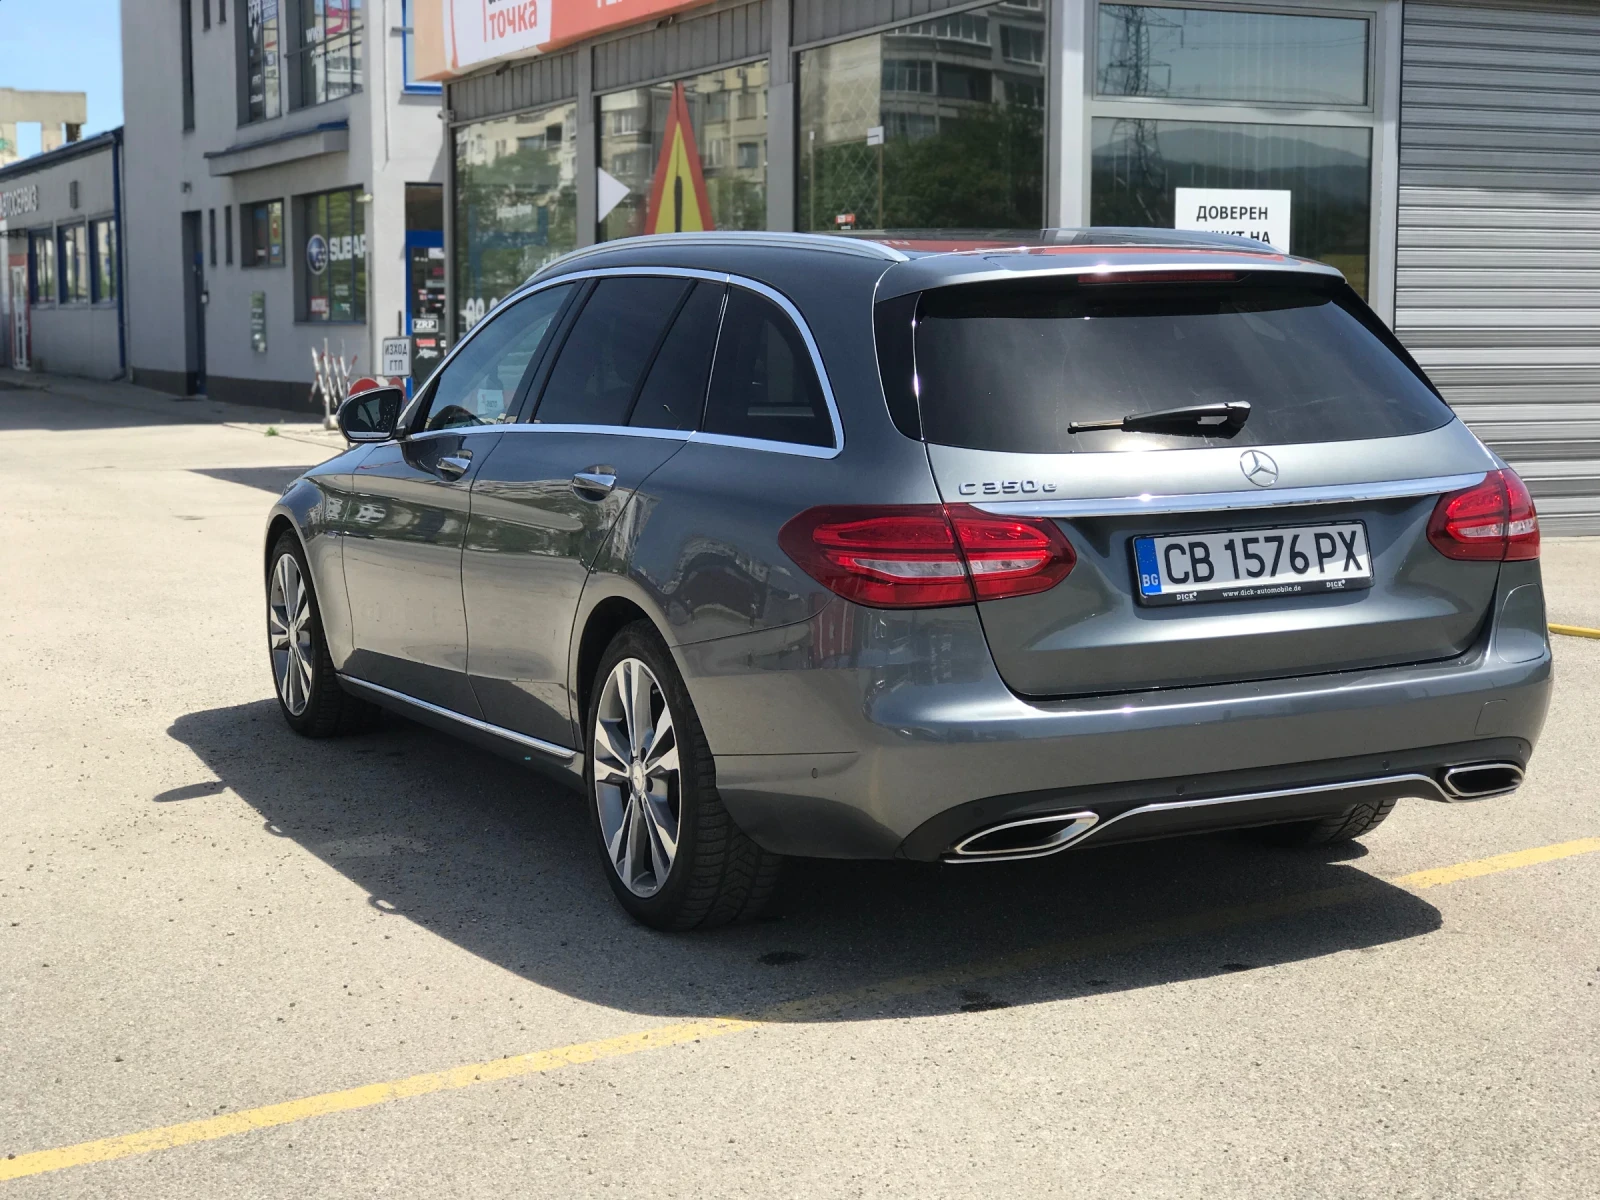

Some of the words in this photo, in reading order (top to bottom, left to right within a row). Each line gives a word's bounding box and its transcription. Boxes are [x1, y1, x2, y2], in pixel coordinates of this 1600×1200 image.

[489, 0, 538, 40] точка
[1196, 205, 1268, 222] ДОВЕРЕН
[329, 234, 366, 261] SUBAR
[415, 320, 435, 329] ZRP
[384, 343, 408, 356] ИЗХОД
[389, 359, 403, 371] ГТП
[1164, 541, 1215, 584] CB
[1224, 534, 1310, 580] 1576
[1313, 530, 1363, 573] PX
[1142, 574, 1159, 587] BG
[1222, 584, 1302, 598] www.dick-automobile.de
